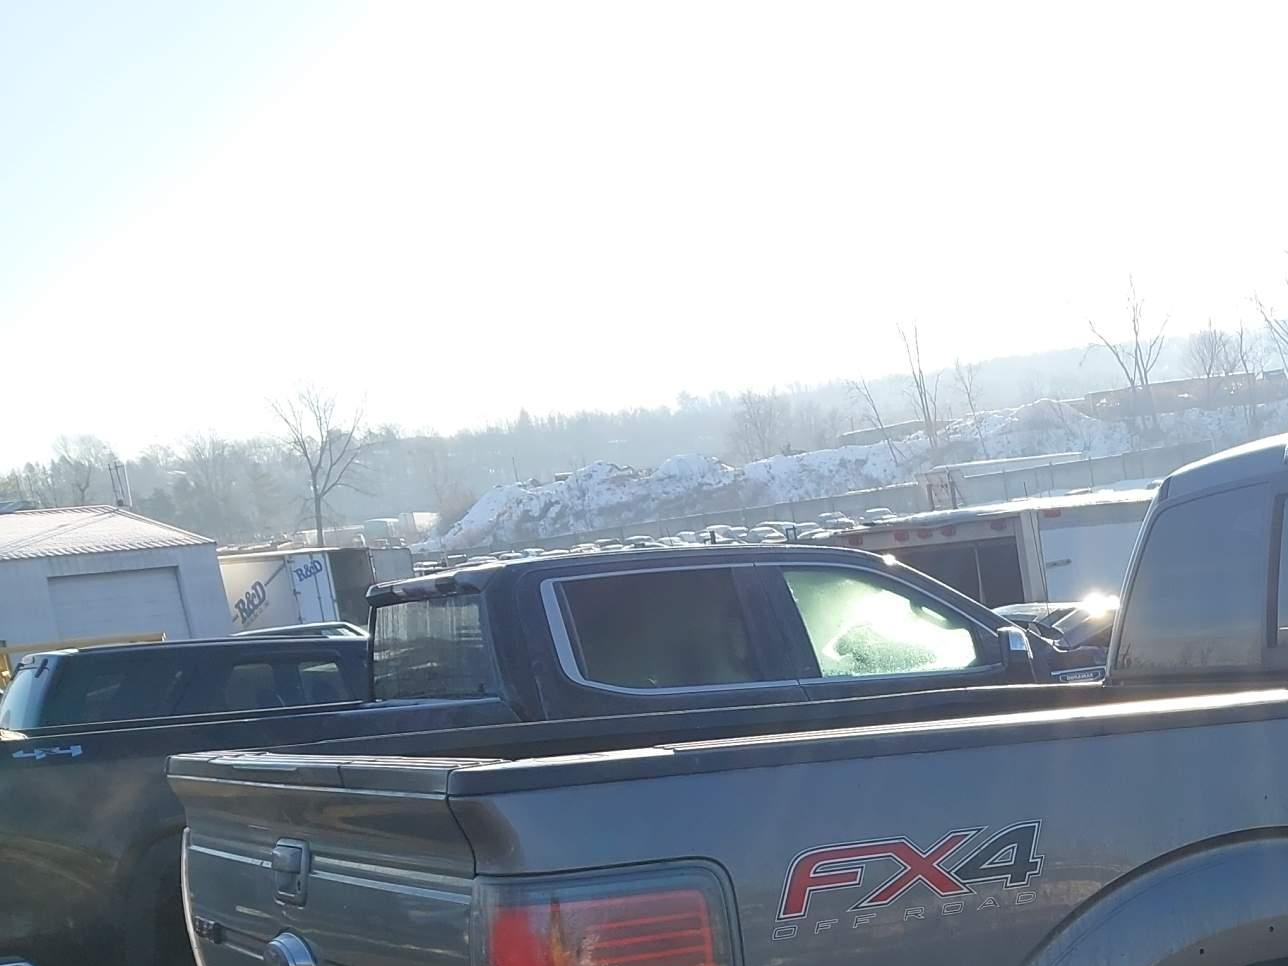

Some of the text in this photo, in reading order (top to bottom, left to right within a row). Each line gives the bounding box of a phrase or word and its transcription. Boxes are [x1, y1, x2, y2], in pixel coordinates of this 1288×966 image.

[293, 560, 323, 583] R&D
[235, 581, 266, 625] R&D
[776, 819, 1044, 922] FX4
[771, 890, 1036, 941] OFF ROAD
